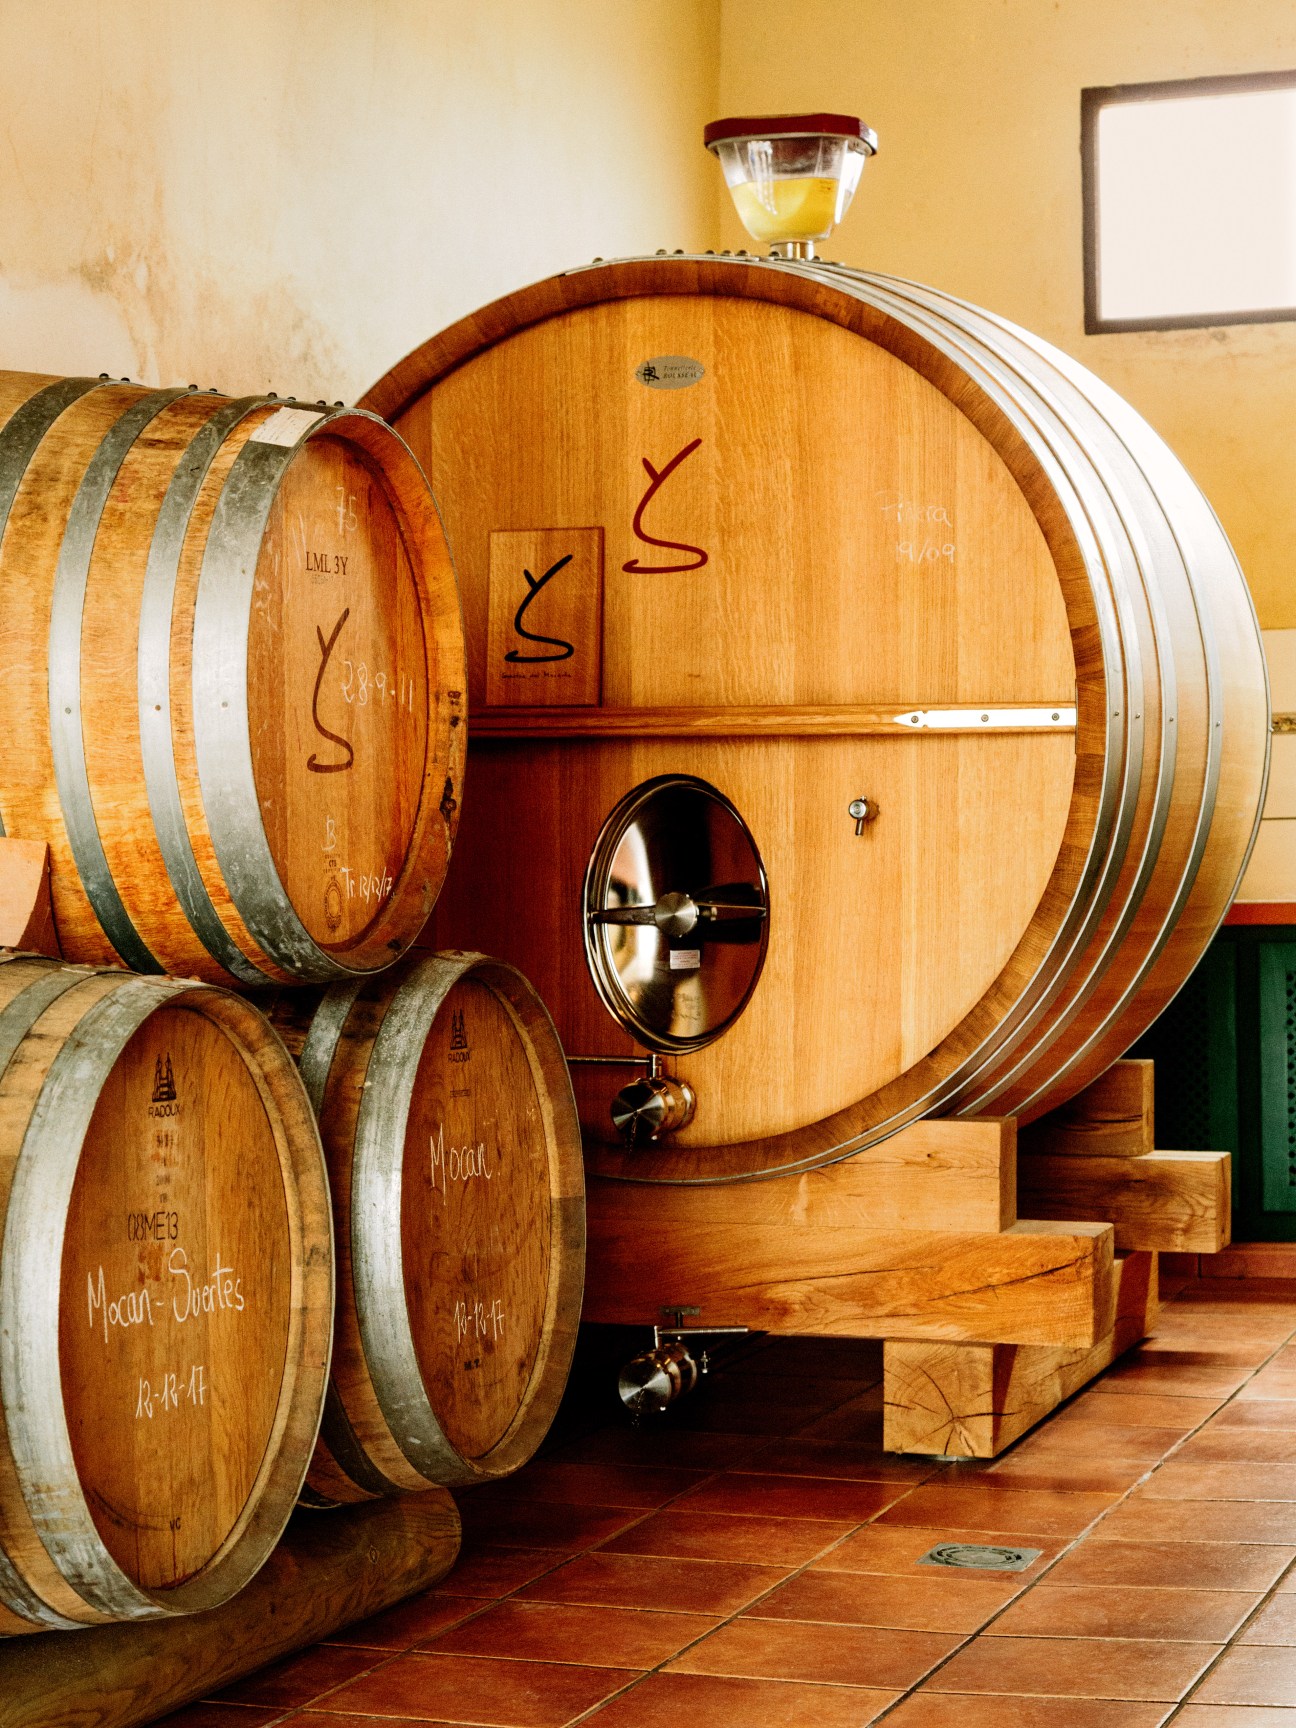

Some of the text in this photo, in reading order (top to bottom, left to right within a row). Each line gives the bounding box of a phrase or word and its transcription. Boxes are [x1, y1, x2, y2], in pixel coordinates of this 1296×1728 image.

[305, 551, 349, 576] LML 3Y
[148, 1103, 181, 1118] RADOUX
[430, 1122, 492, 1206] Mocan
